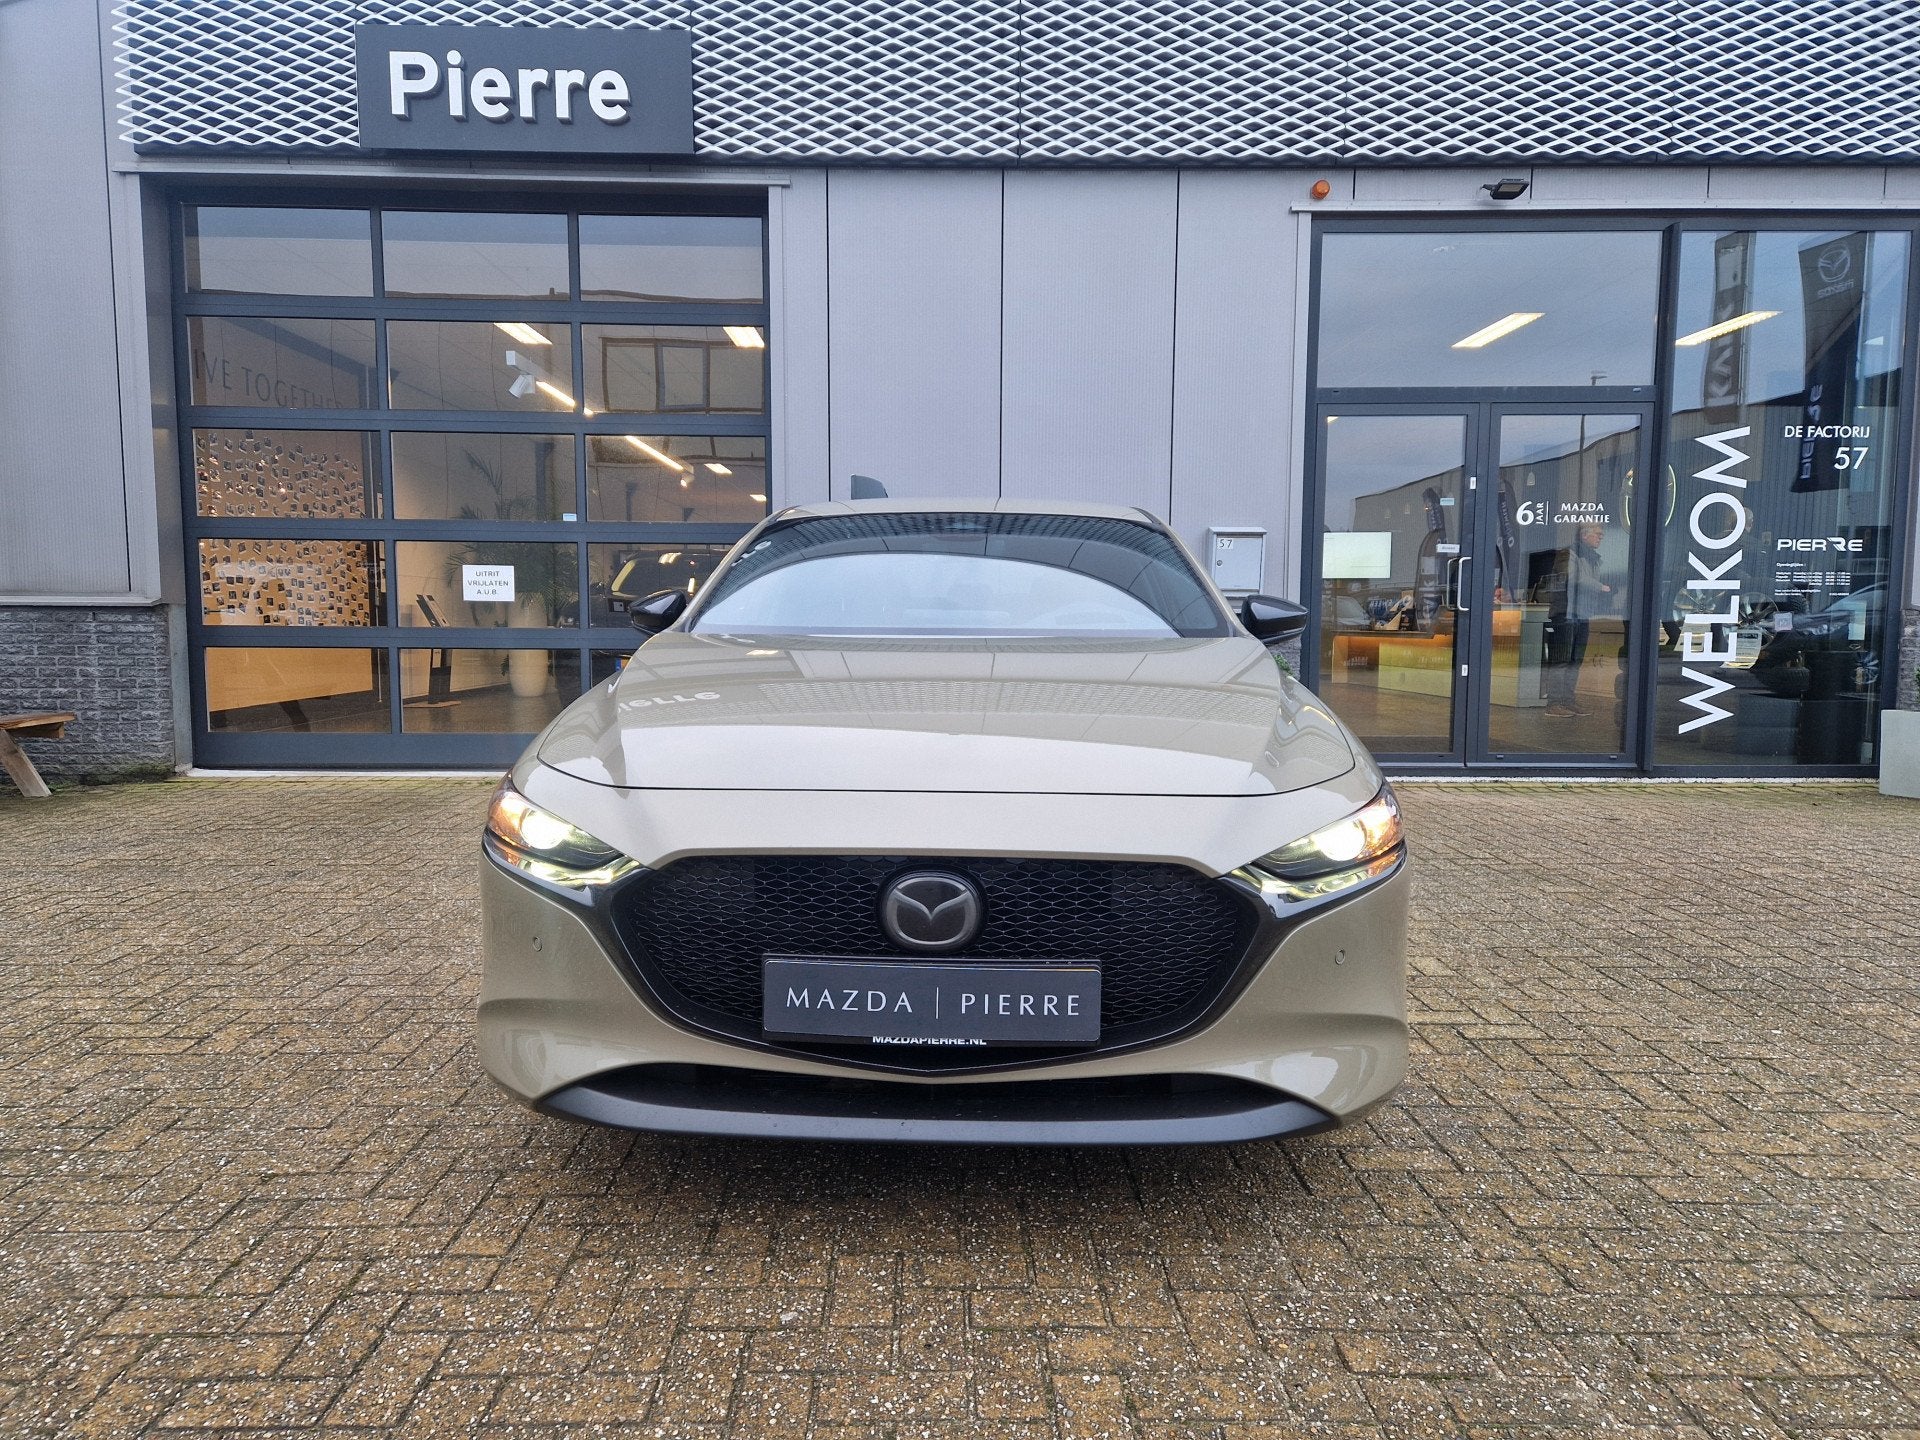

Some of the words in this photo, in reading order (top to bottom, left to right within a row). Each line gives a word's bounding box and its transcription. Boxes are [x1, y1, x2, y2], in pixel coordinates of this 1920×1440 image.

[389, 49, 631, 122] Pierre
[1784, 424, 1804, 439] DE
[1807, 424, 1870, 439] FACTORIJ
[1834, 446, 1869, 470] 57
[1515, 500, 1535, 526] 6
[1535, 502, 1545, 526] JAAR
[1560, 502, 1605, 512] MAZDA
[1553, 514, 1610, 524] GARANTIE
[1219, 538, 1233, 548] 57
[1776, 536, 1864, 552] PIERRE
[1678, 426, 1751, 735] WELKOM
[786, 986, 914, 1014] MAZDA
[960, 992, 1080, 1017] PIERRE
[872, 1035, 987, 1046] MAZDAPIERRE.NL
